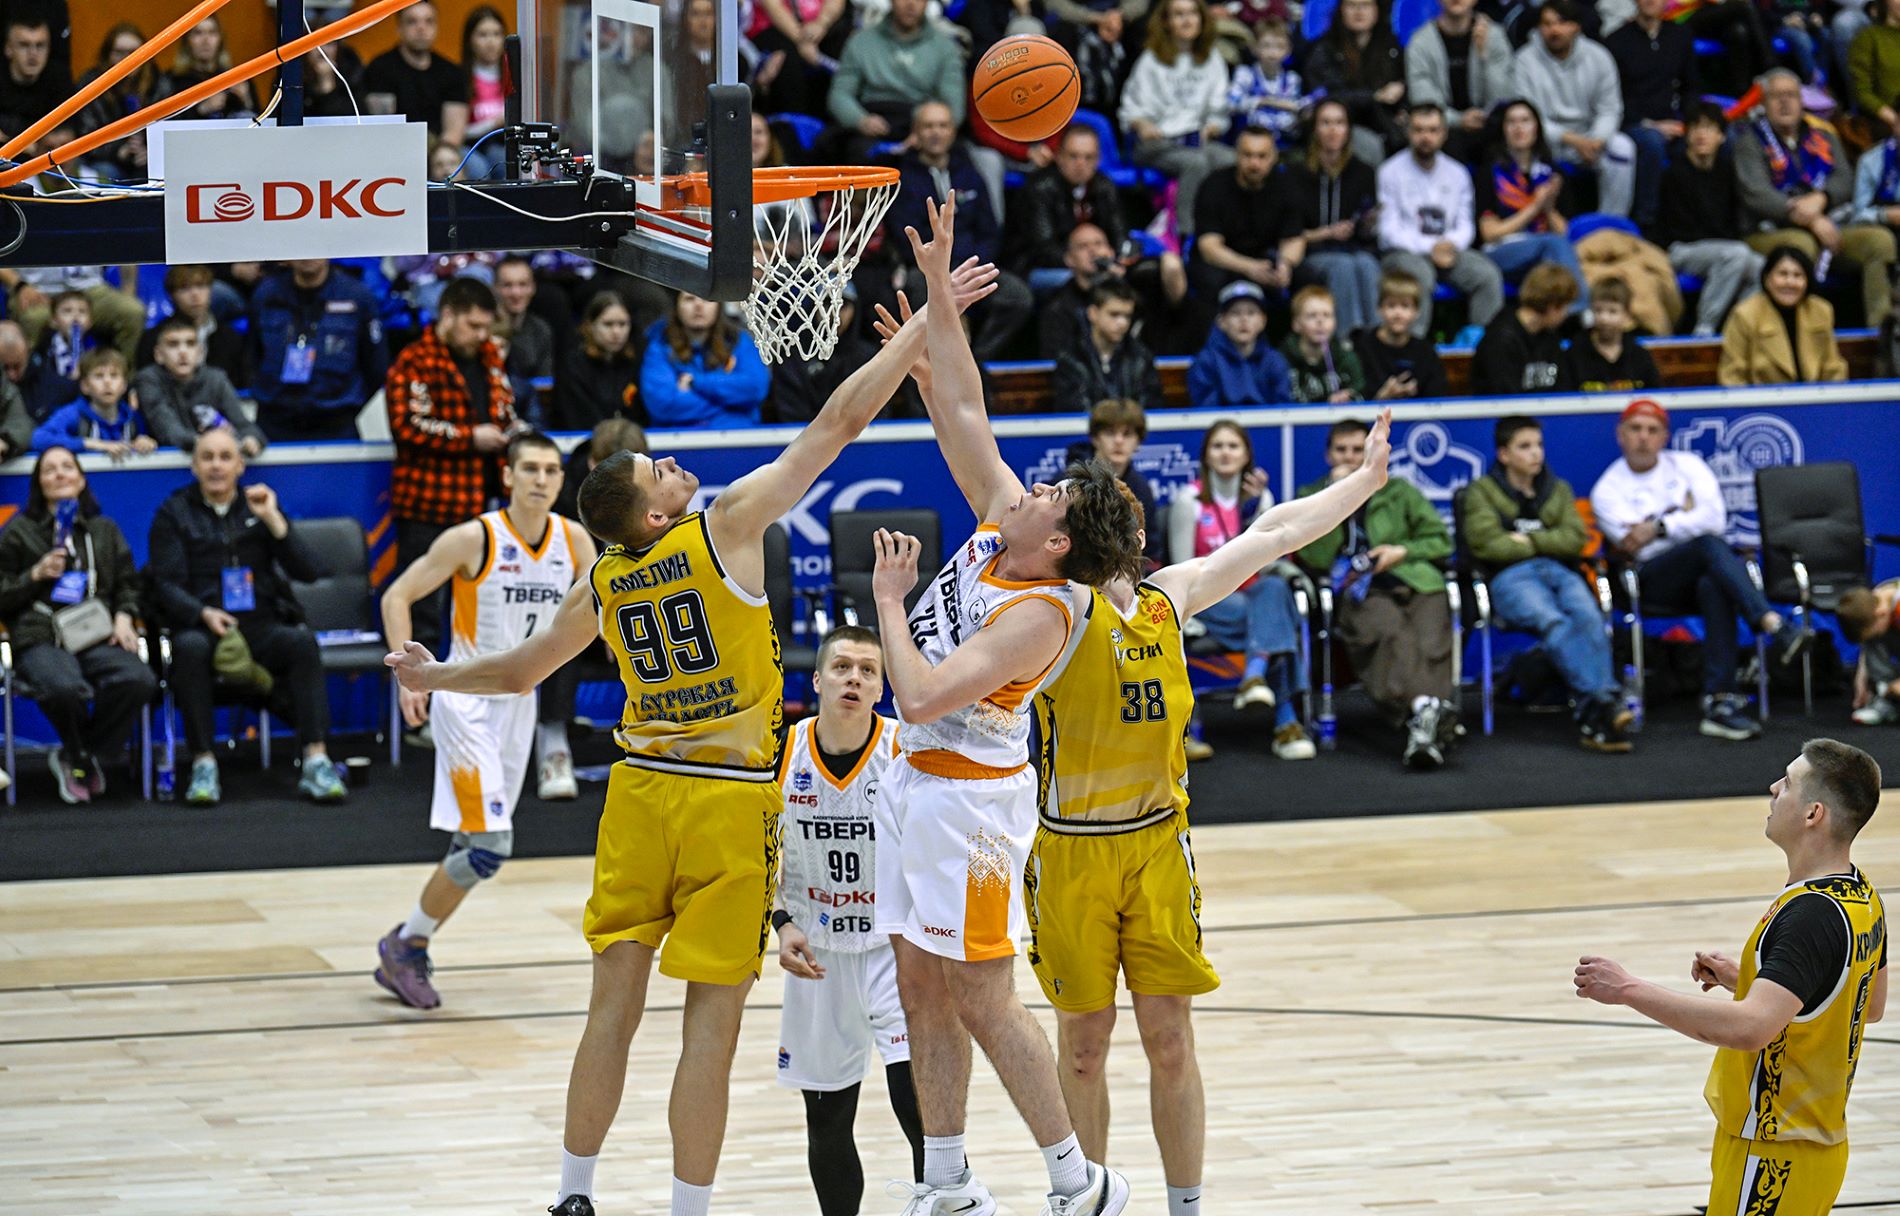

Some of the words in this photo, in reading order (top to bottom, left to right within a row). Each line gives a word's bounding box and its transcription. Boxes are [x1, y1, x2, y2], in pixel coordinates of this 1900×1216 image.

[262, 177, 407, 221] DKC
[609, 550, 693, 594] АМЕЛИН
[503, 586, 564, 604] ТВЕРЬ
[939, 560, 962, 647] ТВЕРЬ
[617, 588, 720, 684] 99
[1151, 609, 1170, 625] BET
[1121, 678, 1168, 723] 38
[828, 850, 860, 883] 99
[832, 916, 872, 933] ВТБ
[930, 926, 957, 938] DKC
